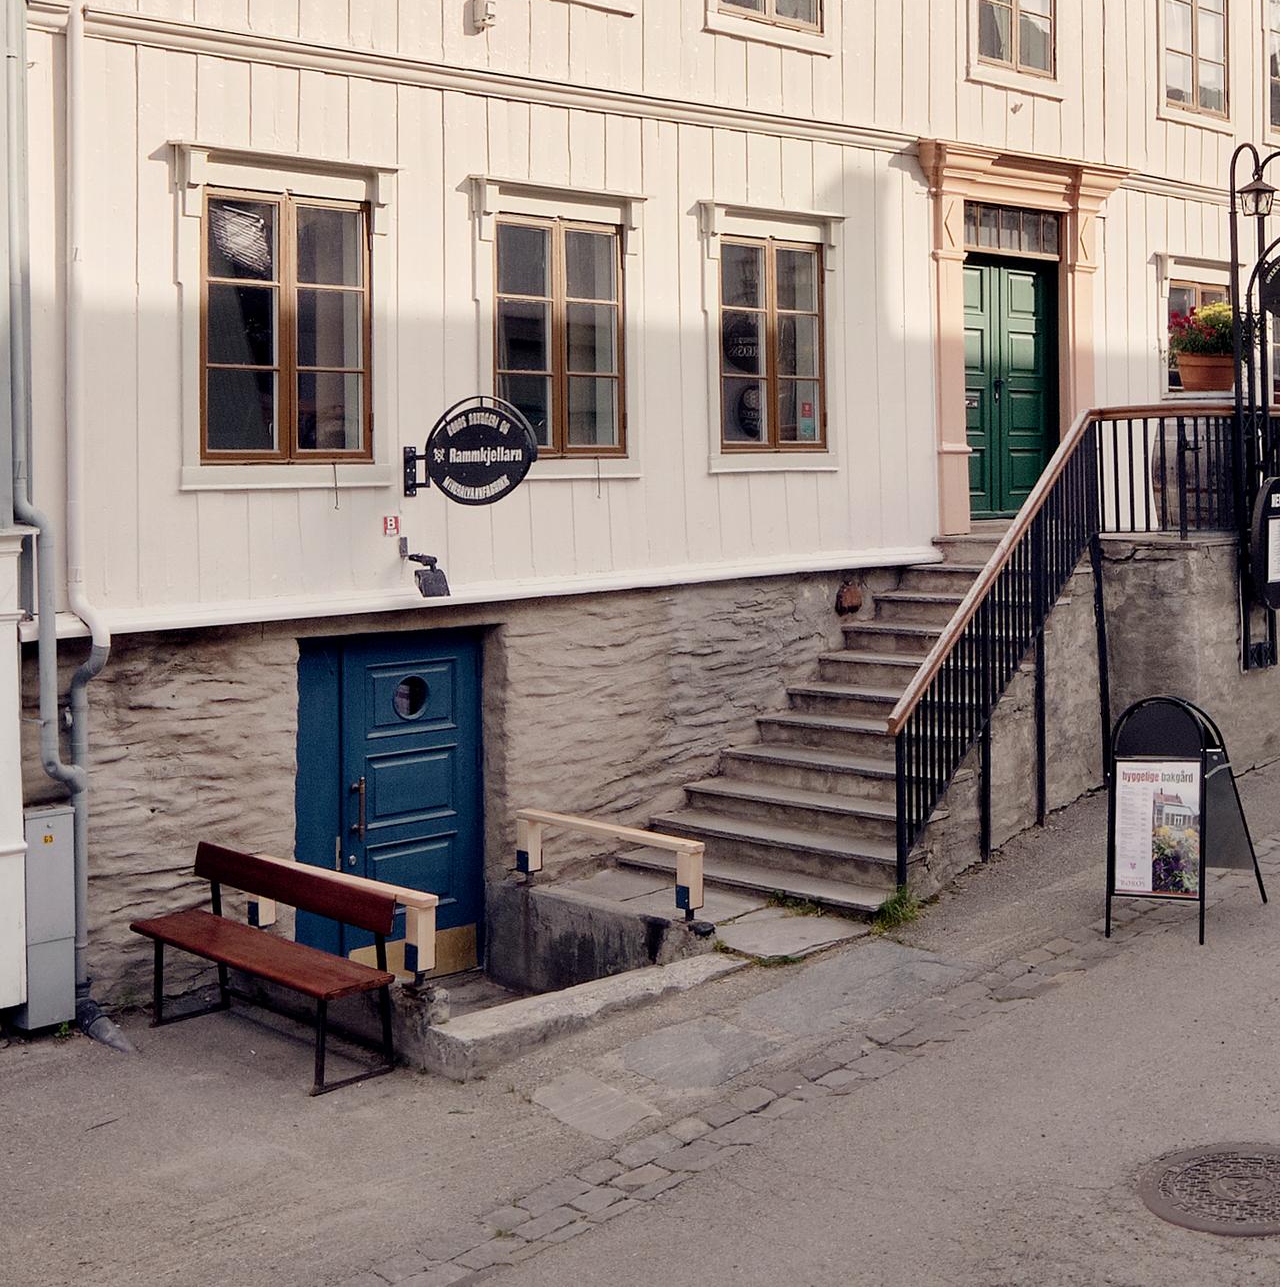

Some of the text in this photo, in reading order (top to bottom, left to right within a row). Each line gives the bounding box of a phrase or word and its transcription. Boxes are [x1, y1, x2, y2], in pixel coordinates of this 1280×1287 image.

[449, 446, 522, 466] Rammkjellarn
[388, 517, 396, 529] B
[1122, 769, 1193, 783] hyggelige bakgård
